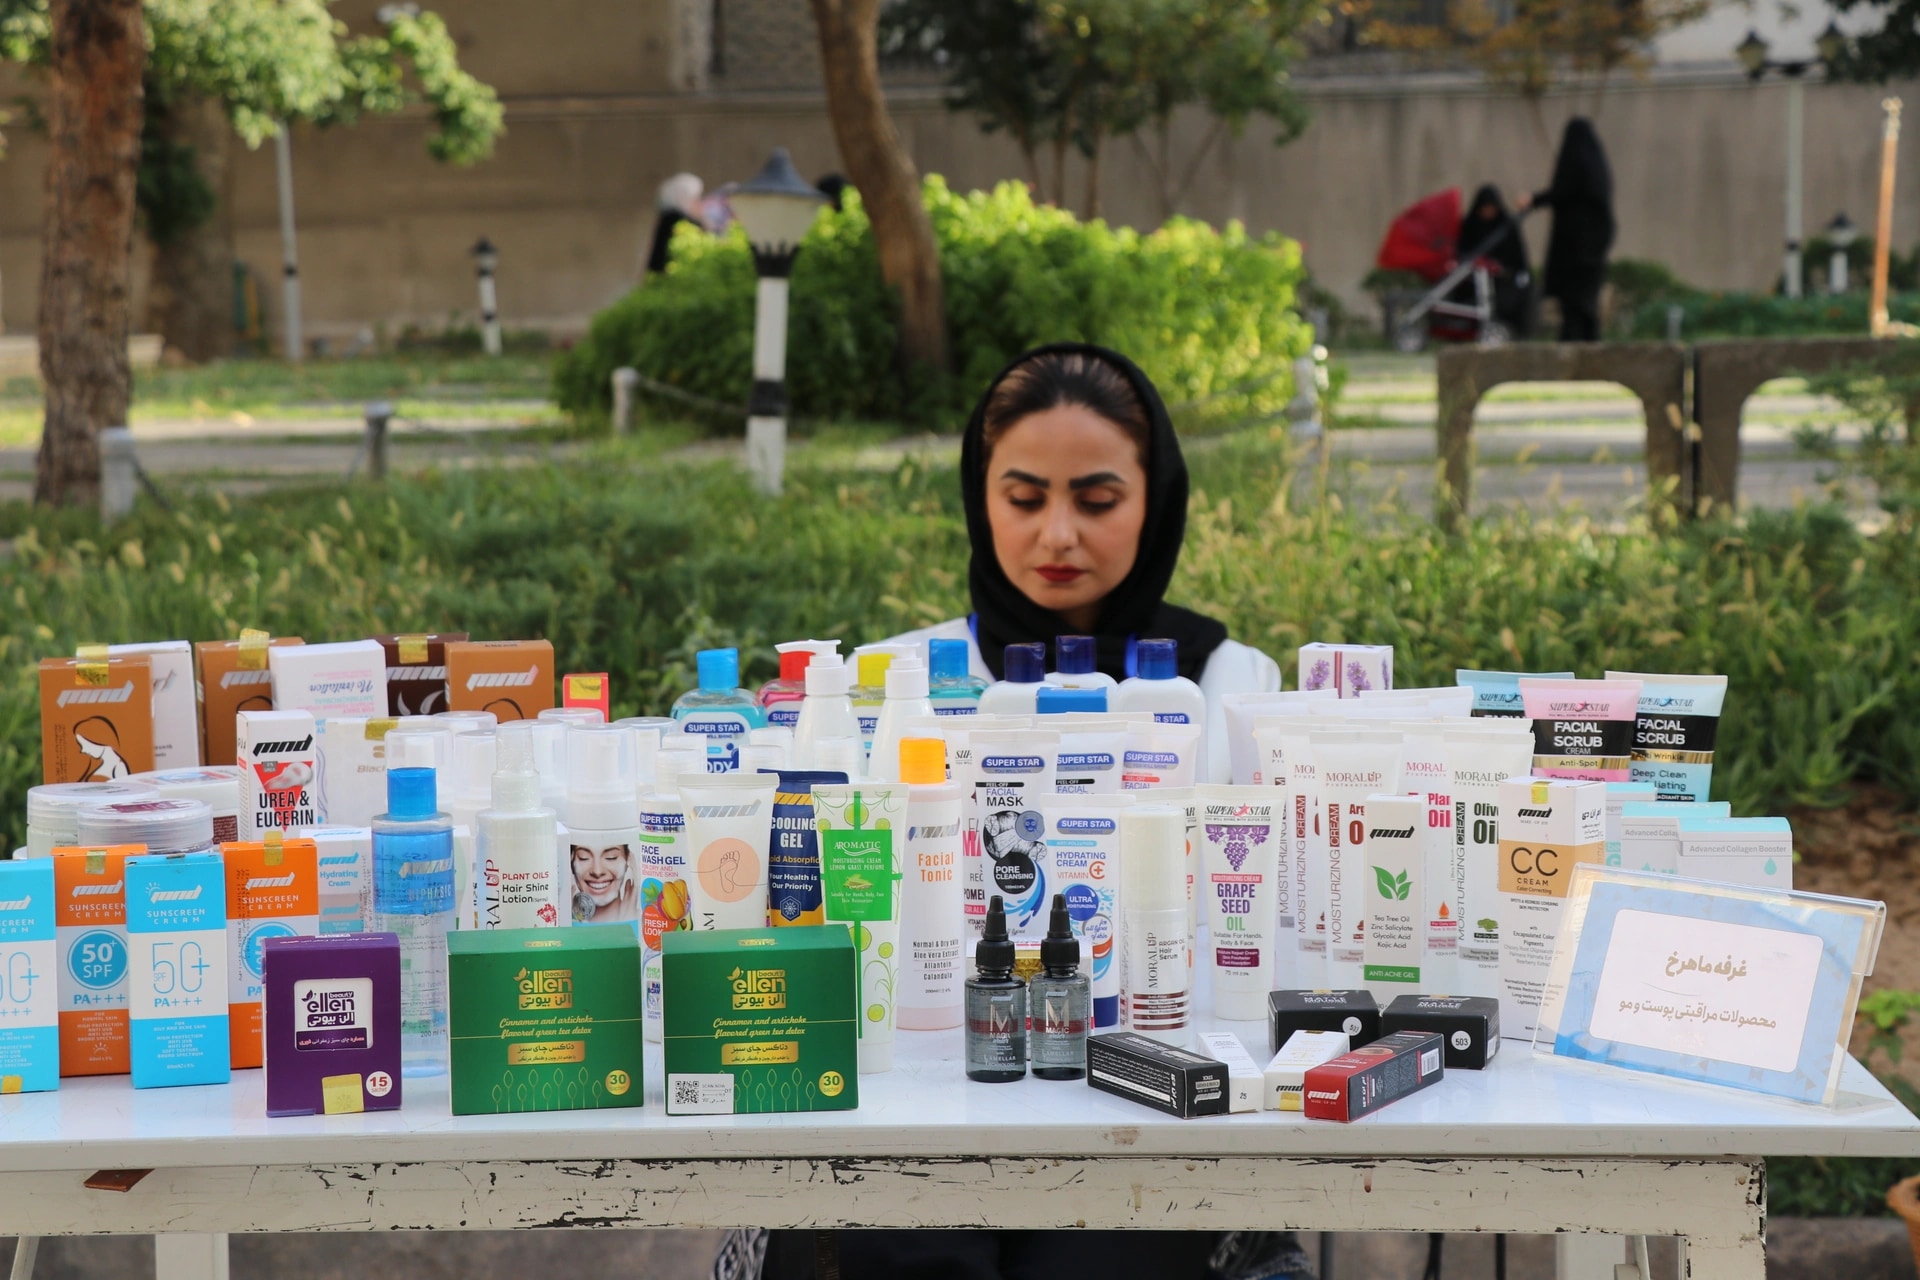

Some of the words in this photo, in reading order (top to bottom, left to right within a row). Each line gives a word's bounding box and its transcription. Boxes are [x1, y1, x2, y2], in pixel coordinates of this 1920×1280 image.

[1549, 702, 1576, 712] SUPER
[1589, 703, 1610, 712] STAR
[772, 713, 799, 721] SUPER
[1160, 715, 1185, 723] STAR
[688, 724, 716, 732] SUPER
[718, 724, 741, 732] STAR
[1554, 721, 1602, 733] FACIAL
[1637, 718, 1685, 731] FACIAL
[1554, 736, 1603, 748] SCRUB
[1637, 732, 1686, 745] SCRUB
[1565, 747, 1591, 755] CREAM
[1057, 755, 1083, 765] SUPER
[1085, 755, 1110, 764] STAR
[1126, 752, 1148, 762] SUPER
[1149, 754, 1175, 762] STAR
[986, 758, 1016, 767] SUPER
[1017, 758, 1040, 767] STAR
[1560, 759, 1598, 768] Anti-Spot
[1632, 768, 1654, 779] Deep
[1659, 769, 1687, 779] Clean
[986, 788, 1018, 796] FACIAL
[1057, 786, 1088, 794] FACIAL
[259, 792, 295, 809] UREA
[300, 791, 309, 806] &
[986, 797, 1024, 806] MASK
[1205, 805, 1235, 815] SUPER
[1248, 806, 1271, 815] STAR
[256, 810, 314, 828] EUCERIN
[640, 814, 661, 824] SUPER
[770, 817, 816, 831] COOLING
[780, 832, 804, 849] GEL
[834, 841, 881, 850] AROMATIC
[641, 846, 660, 855] FACE
[1690, 845, 1725, 853] Advanced
[1727, 845, 1757, 854] Collagen
[1759, 845, 1786, 853] Booster
[641, 856, 664, 865] WASH
[666, 856, 686, 865] GEL
[918, 852, 954, 866] Facial
[1056, 852, 1106, 860] HYDRATING
[1511, 847, 1558, 876] CC
[320, 870, 359, 879] Hydrating
[502, 873, 530, 881] PLANT
[532, 871, 549, 879] OILS
[769, 873, 783, 881] Your
[784, 873, 809, 881] Health
[921, 869, 952, 882] Tonic
[786, 882, 813, 891] Priority
[1517, 878, 1549, 886] CREAM
[502, 884, 523, 893] Hair
[526, 883, 549, 892] Shine
[1217, 883, 1255, 898] GRAPE
[243, 895, 299, 904] SUNSCREEN
[69, 903, 127, 911] SUNSCREEN
[249, 902, 294, 911] CREAM
[1222, 899, 1250, 913] SEED
[147, 908, 206, 918] SUNSCREEN
[154, 916, 200, 924] CREAM
[644, 919, 668, 928] FRESH
[1227, 917, 1245, 931] OIL
[644, 928, 663, 936] LOOK
[1385, 924, 1413, 933] Salicylate
[1373, 933, 1395, 941] Glycolic
[914, 951, 926, 959] Aloe
[928, 951, 941, 959] Vera
[924, 961, 952, 969] Allantoin
[1715, 957, 1748, 981] غرفه
[83, 965, 113, 978] SPF
[924, 972, 952, 980] Calandula
[153, 972, 168, 982] SPF
[520, 971, 572, 993] ellen
[733, 970, 786, 993] ellen
[307, 993, 355, 1013] ellen
[1619, 1000, 1633, 1012] مو
[1642, 1001, 1674, 1022] پوست
[1674, 1002, 1718, 1021] مراقبتی
[500, 1018, 539, 1028] Cinnamon
[540, 1017, 556, 1025] and
[558, 1016, 593, 1024] artichoke
[713, 1018, 752, 1028] Cinnamon
[754, 1017, 769, 1025] and
[771, 1017, 807, 1025] artichoke
[1720, 1009, 1777, 1029] محصولات
[501, 1028, 534, 1039] flavored
[536, 1029, 557, 1038] green
[715, 1029, 747, 1039] flavored
[749, 1029, 770, 1038] green
[1455, 1038, 1468, 1046] 503
[369, 1076, 387, 1088] 15
[610, 1074, 627, 1084] 30
[823, 1075, 840, 1086] 30
